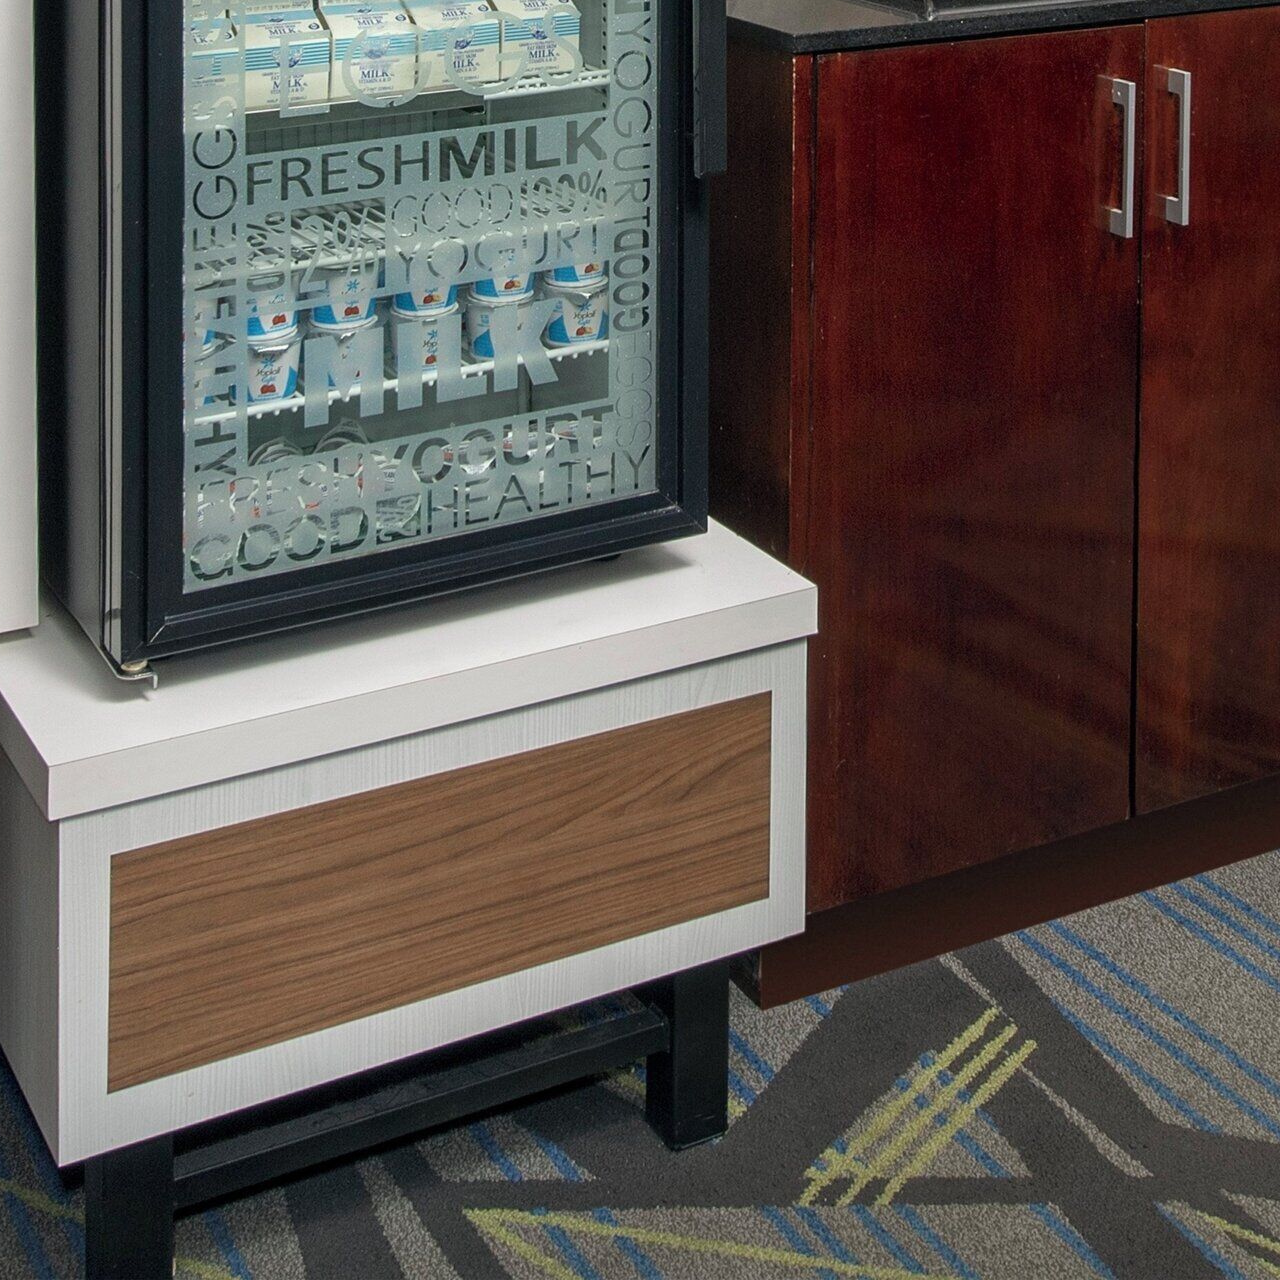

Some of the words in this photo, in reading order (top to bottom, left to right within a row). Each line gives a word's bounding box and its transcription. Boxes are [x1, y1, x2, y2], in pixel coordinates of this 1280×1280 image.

[247, 141, 430, 206] FRESH
[439, 117, 608, 183] MILK
[614, 15, 653, 228] YOGURT
[304, 302, 559, 428] MILK
[370, 404, 614, 492] YOGURT
[427, 444, 651, 535] HEALTHY
[190, 505, 370, 582] GOOD
